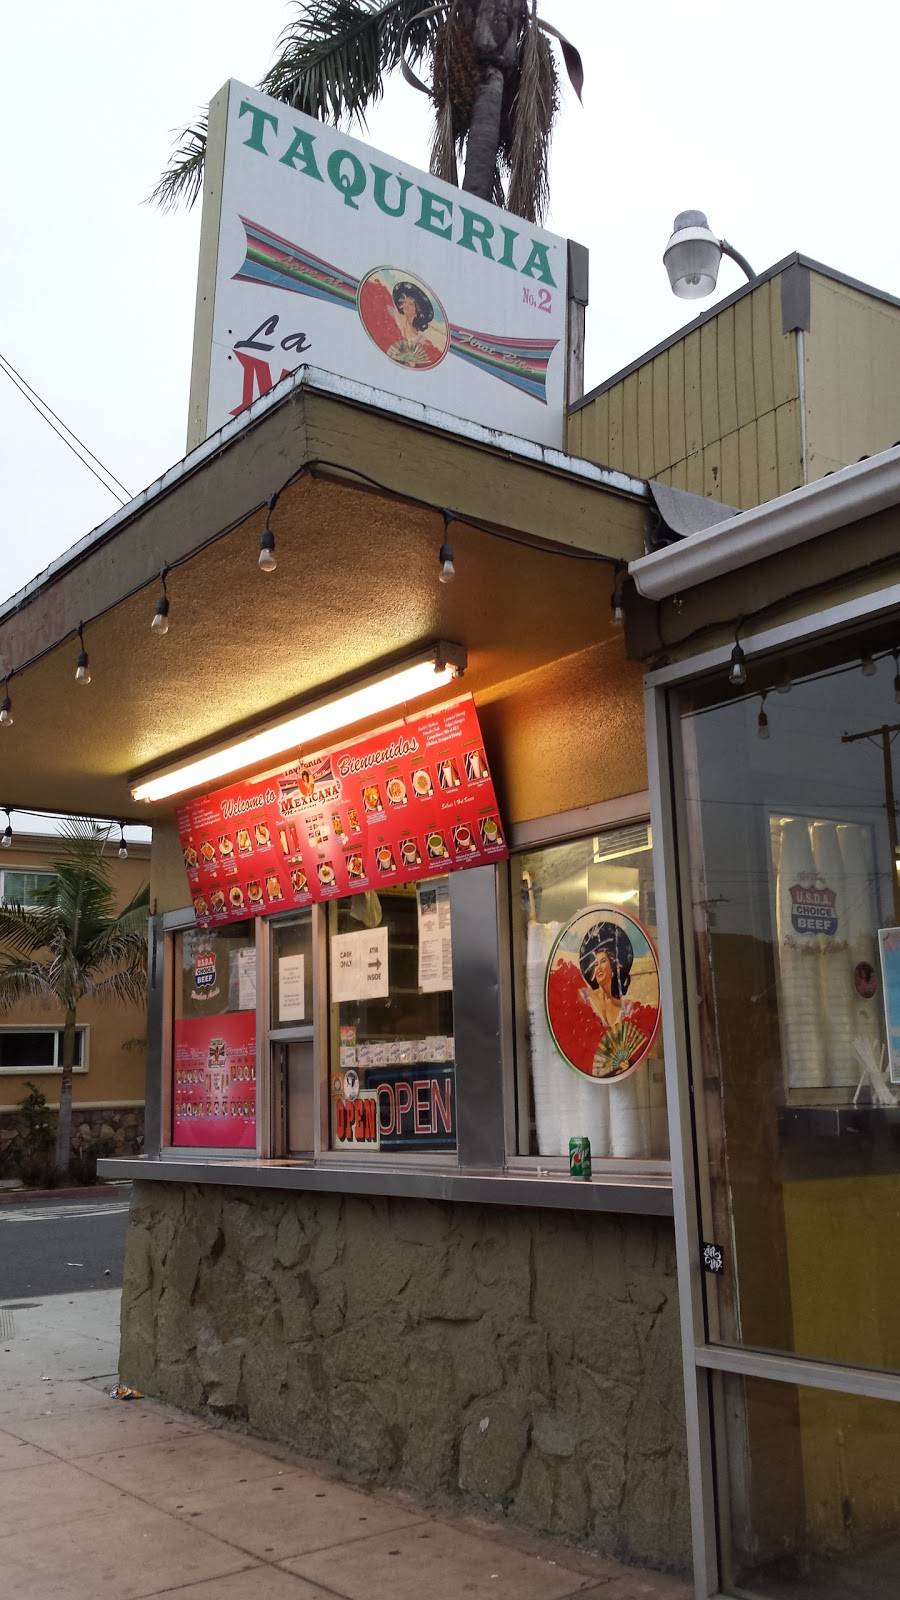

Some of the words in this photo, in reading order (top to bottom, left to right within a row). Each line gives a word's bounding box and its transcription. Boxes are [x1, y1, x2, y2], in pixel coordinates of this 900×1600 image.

[238, 100, 557, 288] TAQUERIA
[234, 314, 312, 353] La
[337, 737, 419, 777] Bienvenidos
[221, 795, 263, 819] Welcome
[265, 787, 277, 804] to
[280, 785, 339, 813] MEXICANA
[796, 905, 833, 916] CHOICE
[797, 918, 832, 930] BEEF
[197, 975, 213, 984] BEEF
[336, 1098, 378, 1142] OPEN
[376, 1078, 452, 1135] OPEN
